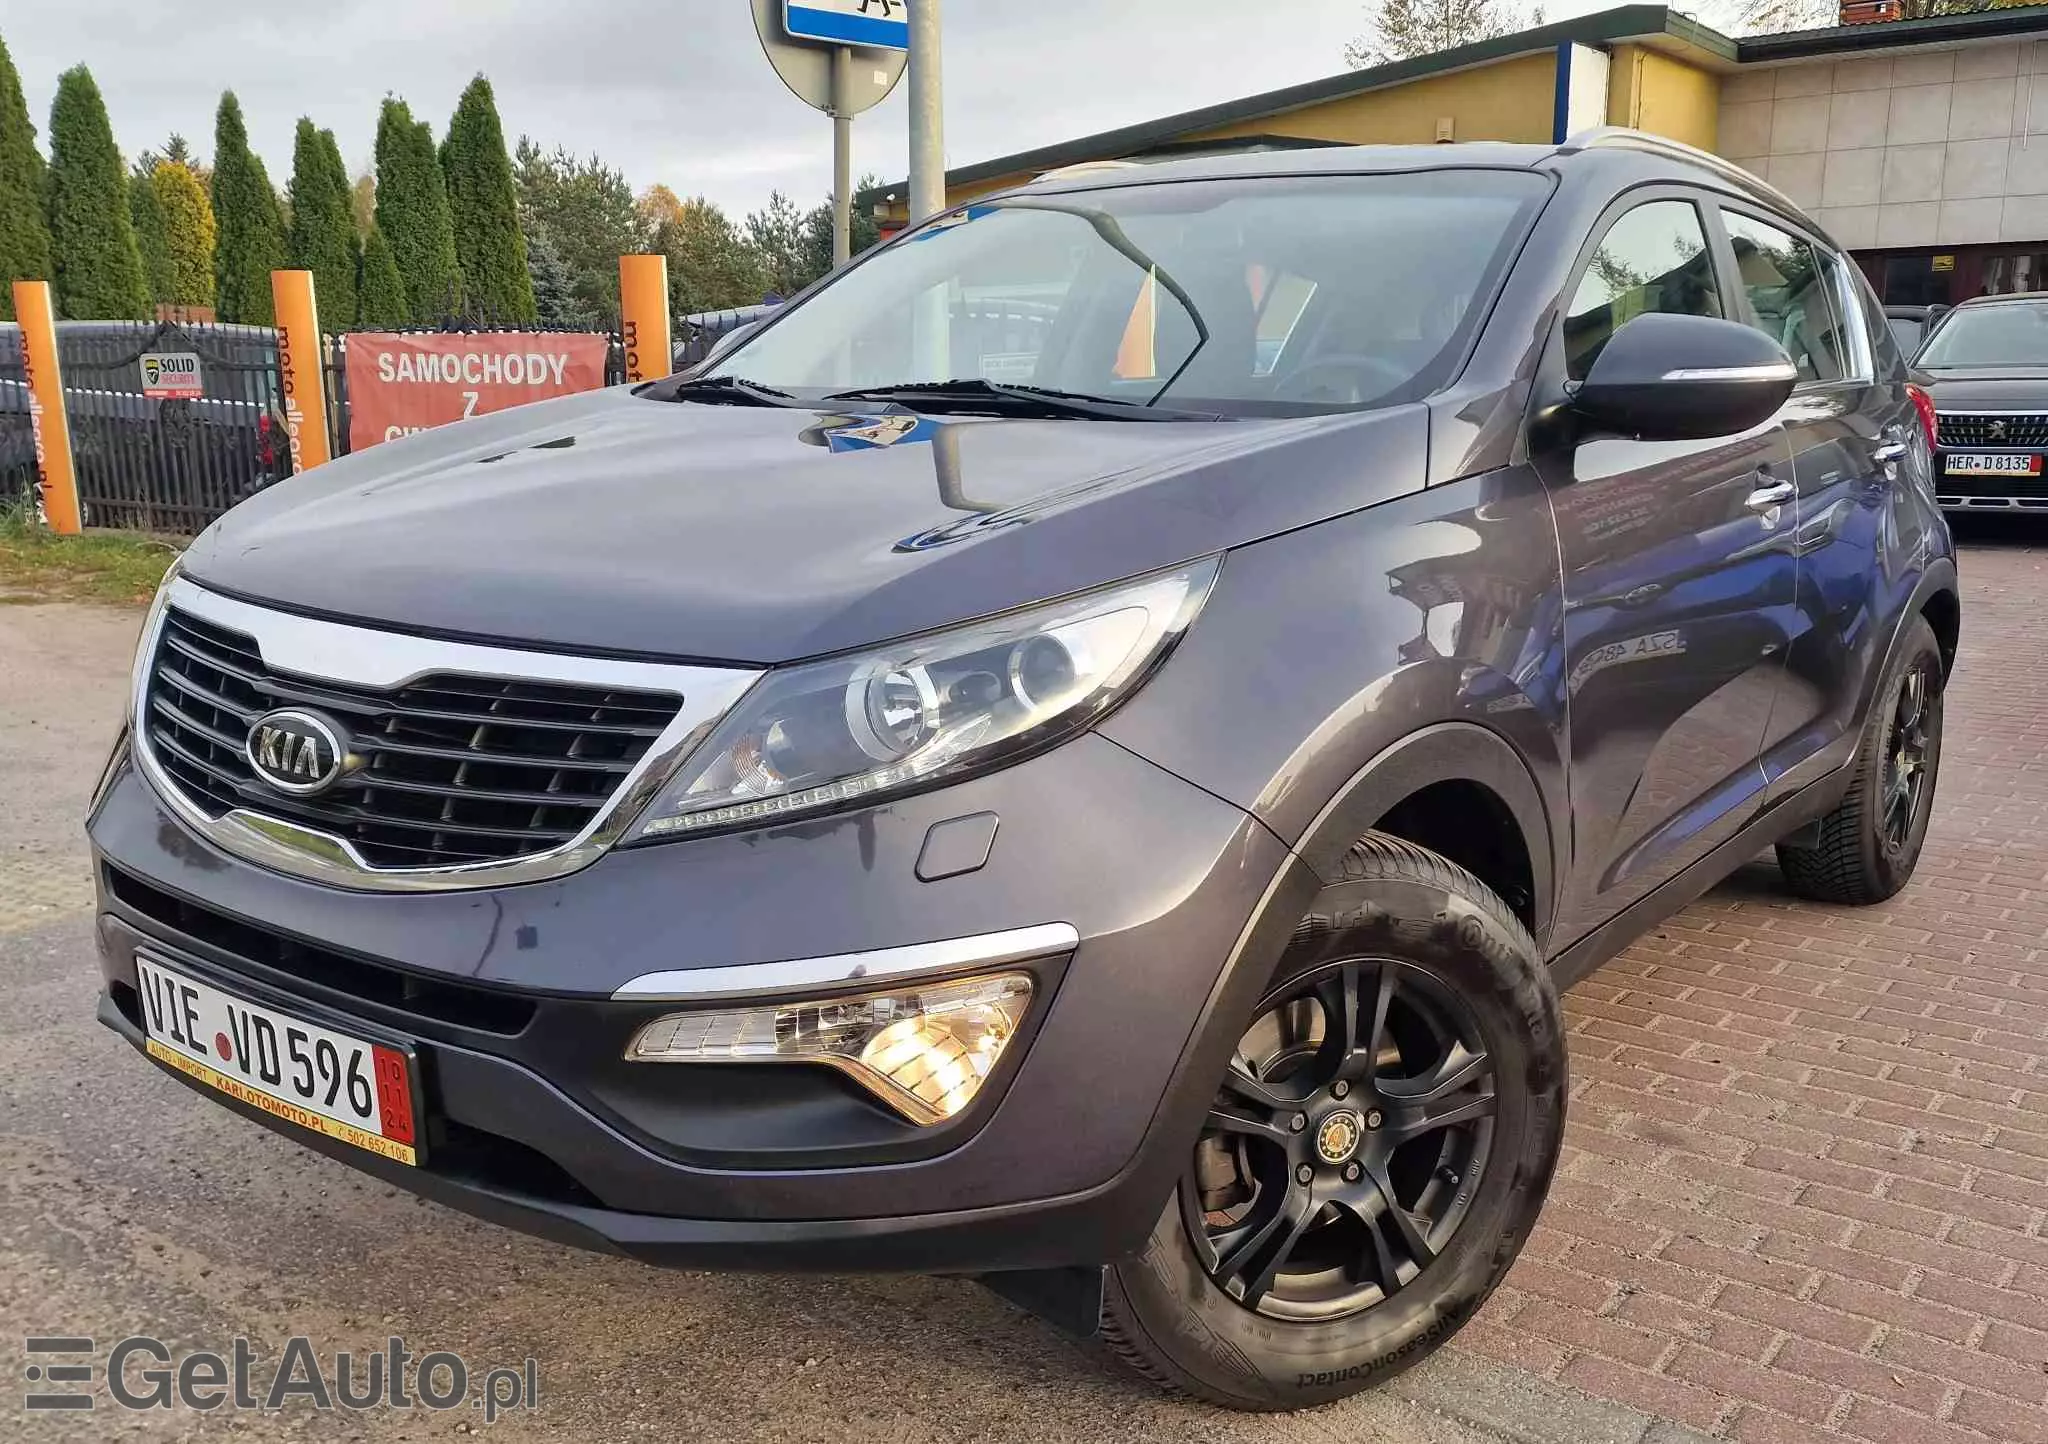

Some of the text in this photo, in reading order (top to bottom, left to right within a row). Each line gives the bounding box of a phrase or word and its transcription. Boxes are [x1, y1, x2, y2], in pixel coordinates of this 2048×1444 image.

[160, 358, 194, 372] SOLID
[378, 352, 568, 385] SAMOCHODY
[462, 391, 480, 419] Z
[1948, 456, 1974, 469] HER
[259, 726, 320, 779] KIA
[142, 966, 208, 1056] VIE
[347, 1129, 365, 1147] 502
[368, 1136, 386, 1154] 652
